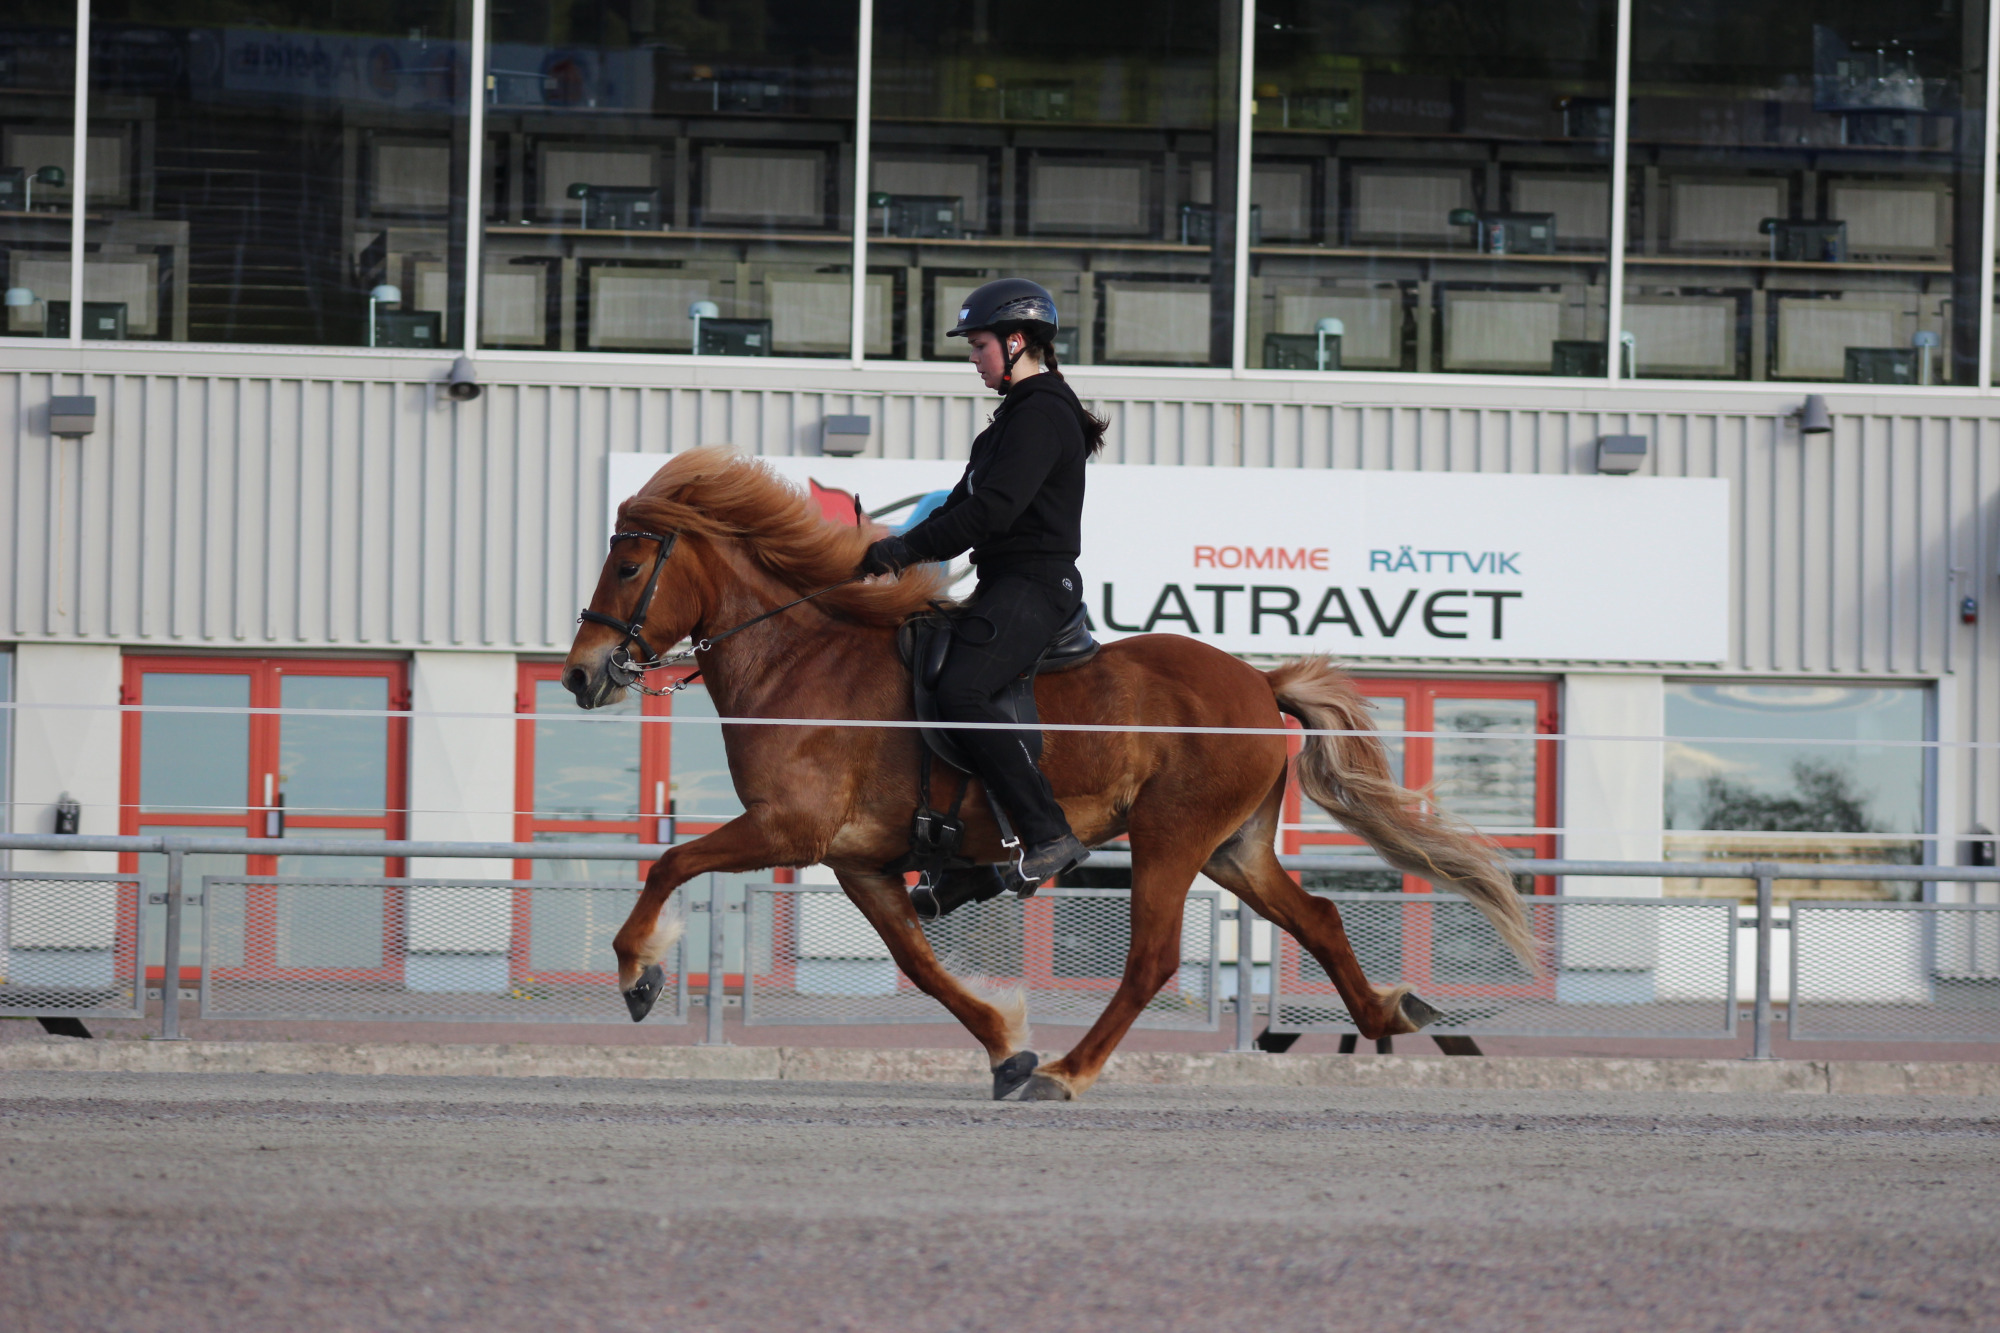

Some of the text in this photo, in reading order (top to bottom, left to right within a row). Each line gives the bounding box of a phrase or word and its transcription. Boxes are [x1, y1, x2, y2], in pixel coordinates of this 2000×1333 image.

[1193, 545, 1329, 570] ROMME
[1369, 546, 1522, 574] RÄTTVIK
[1086, 582, 1522, 640] LATRAVET
